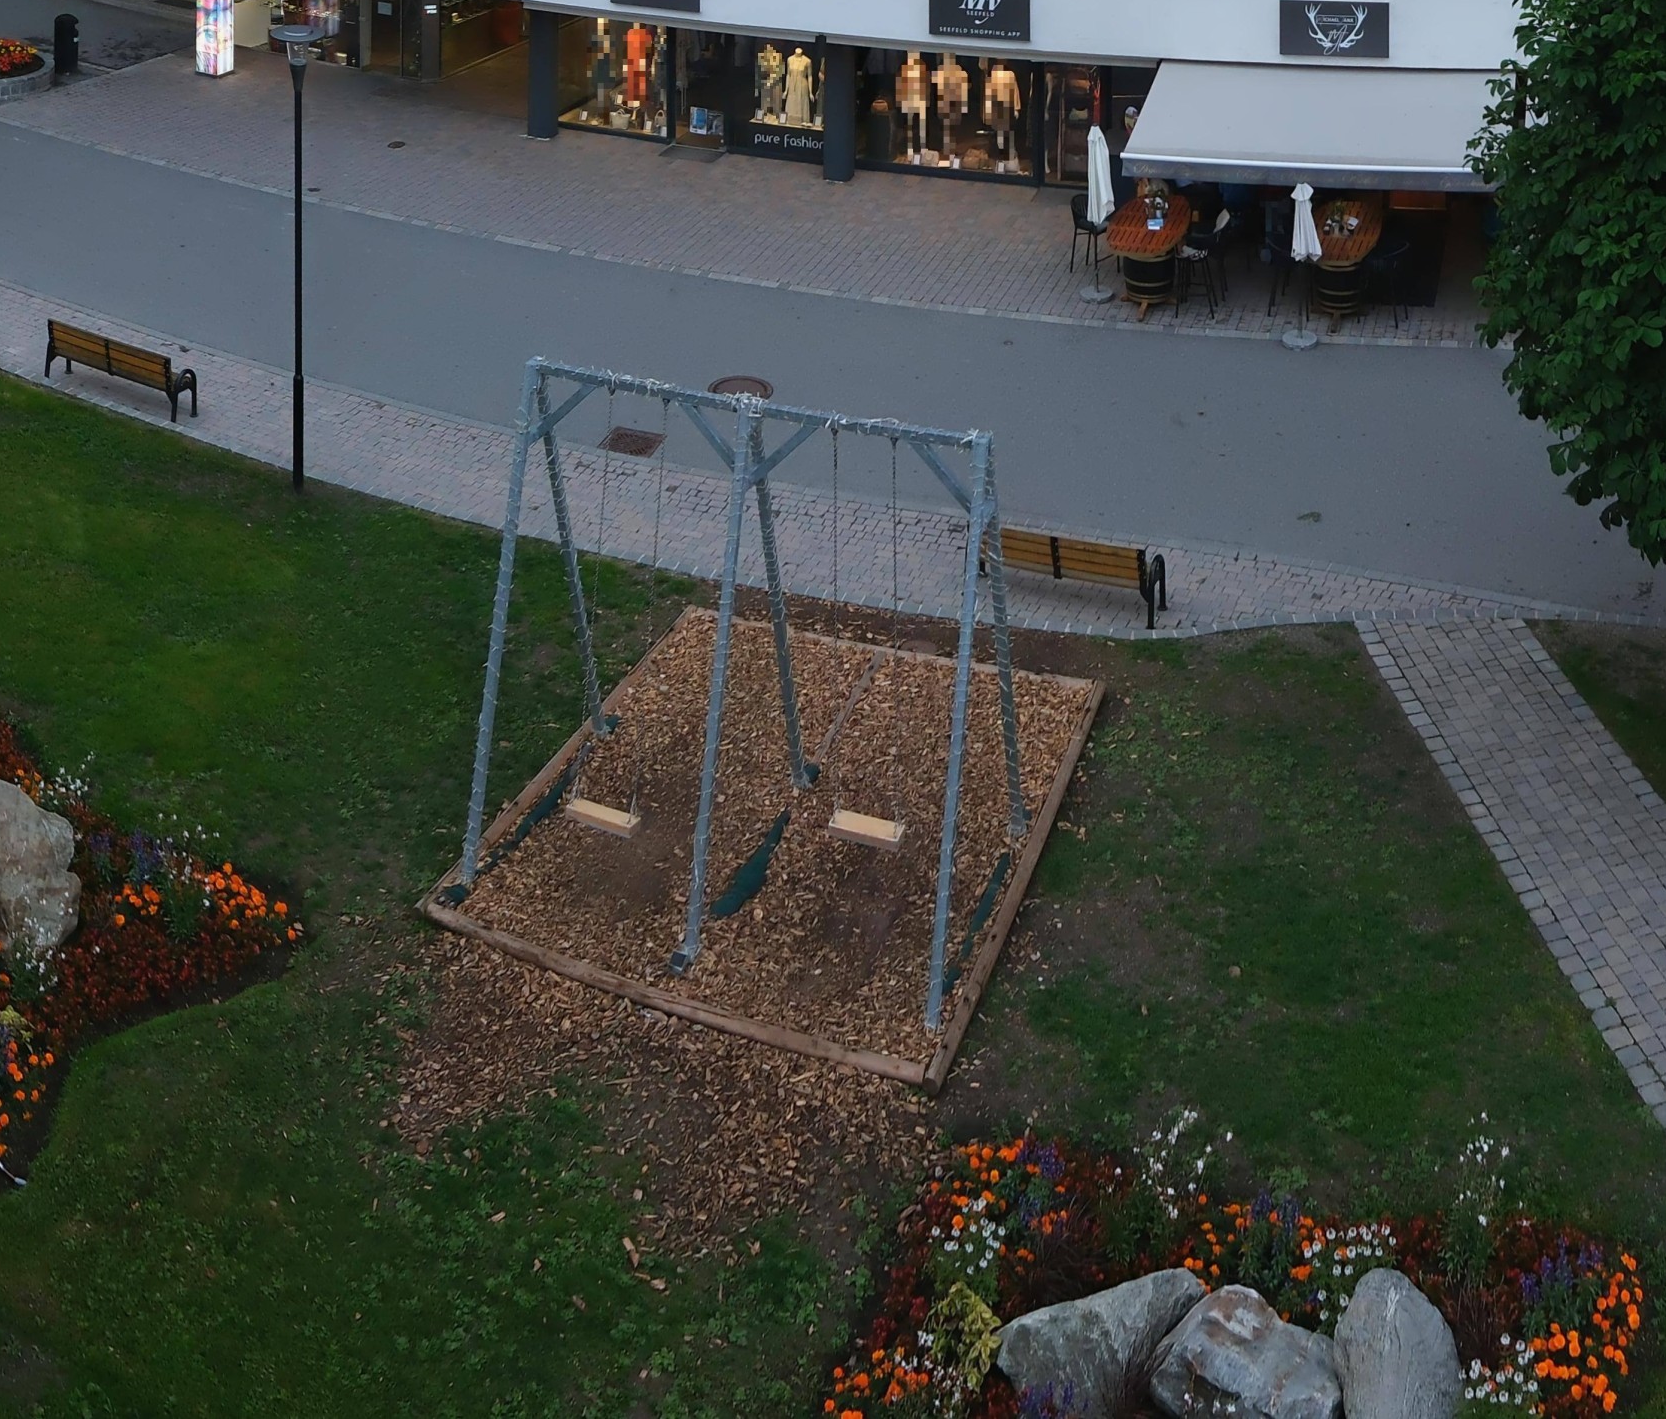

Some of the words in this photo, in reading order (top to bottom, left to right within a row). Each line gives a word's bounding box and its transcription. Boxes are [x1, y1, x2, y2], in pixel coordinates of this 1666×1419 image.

[939, 26, 968, 34] SEEFELD
[970, 28, 1005, 36] SHOPPING
[754, 133, 780, 145] pure
